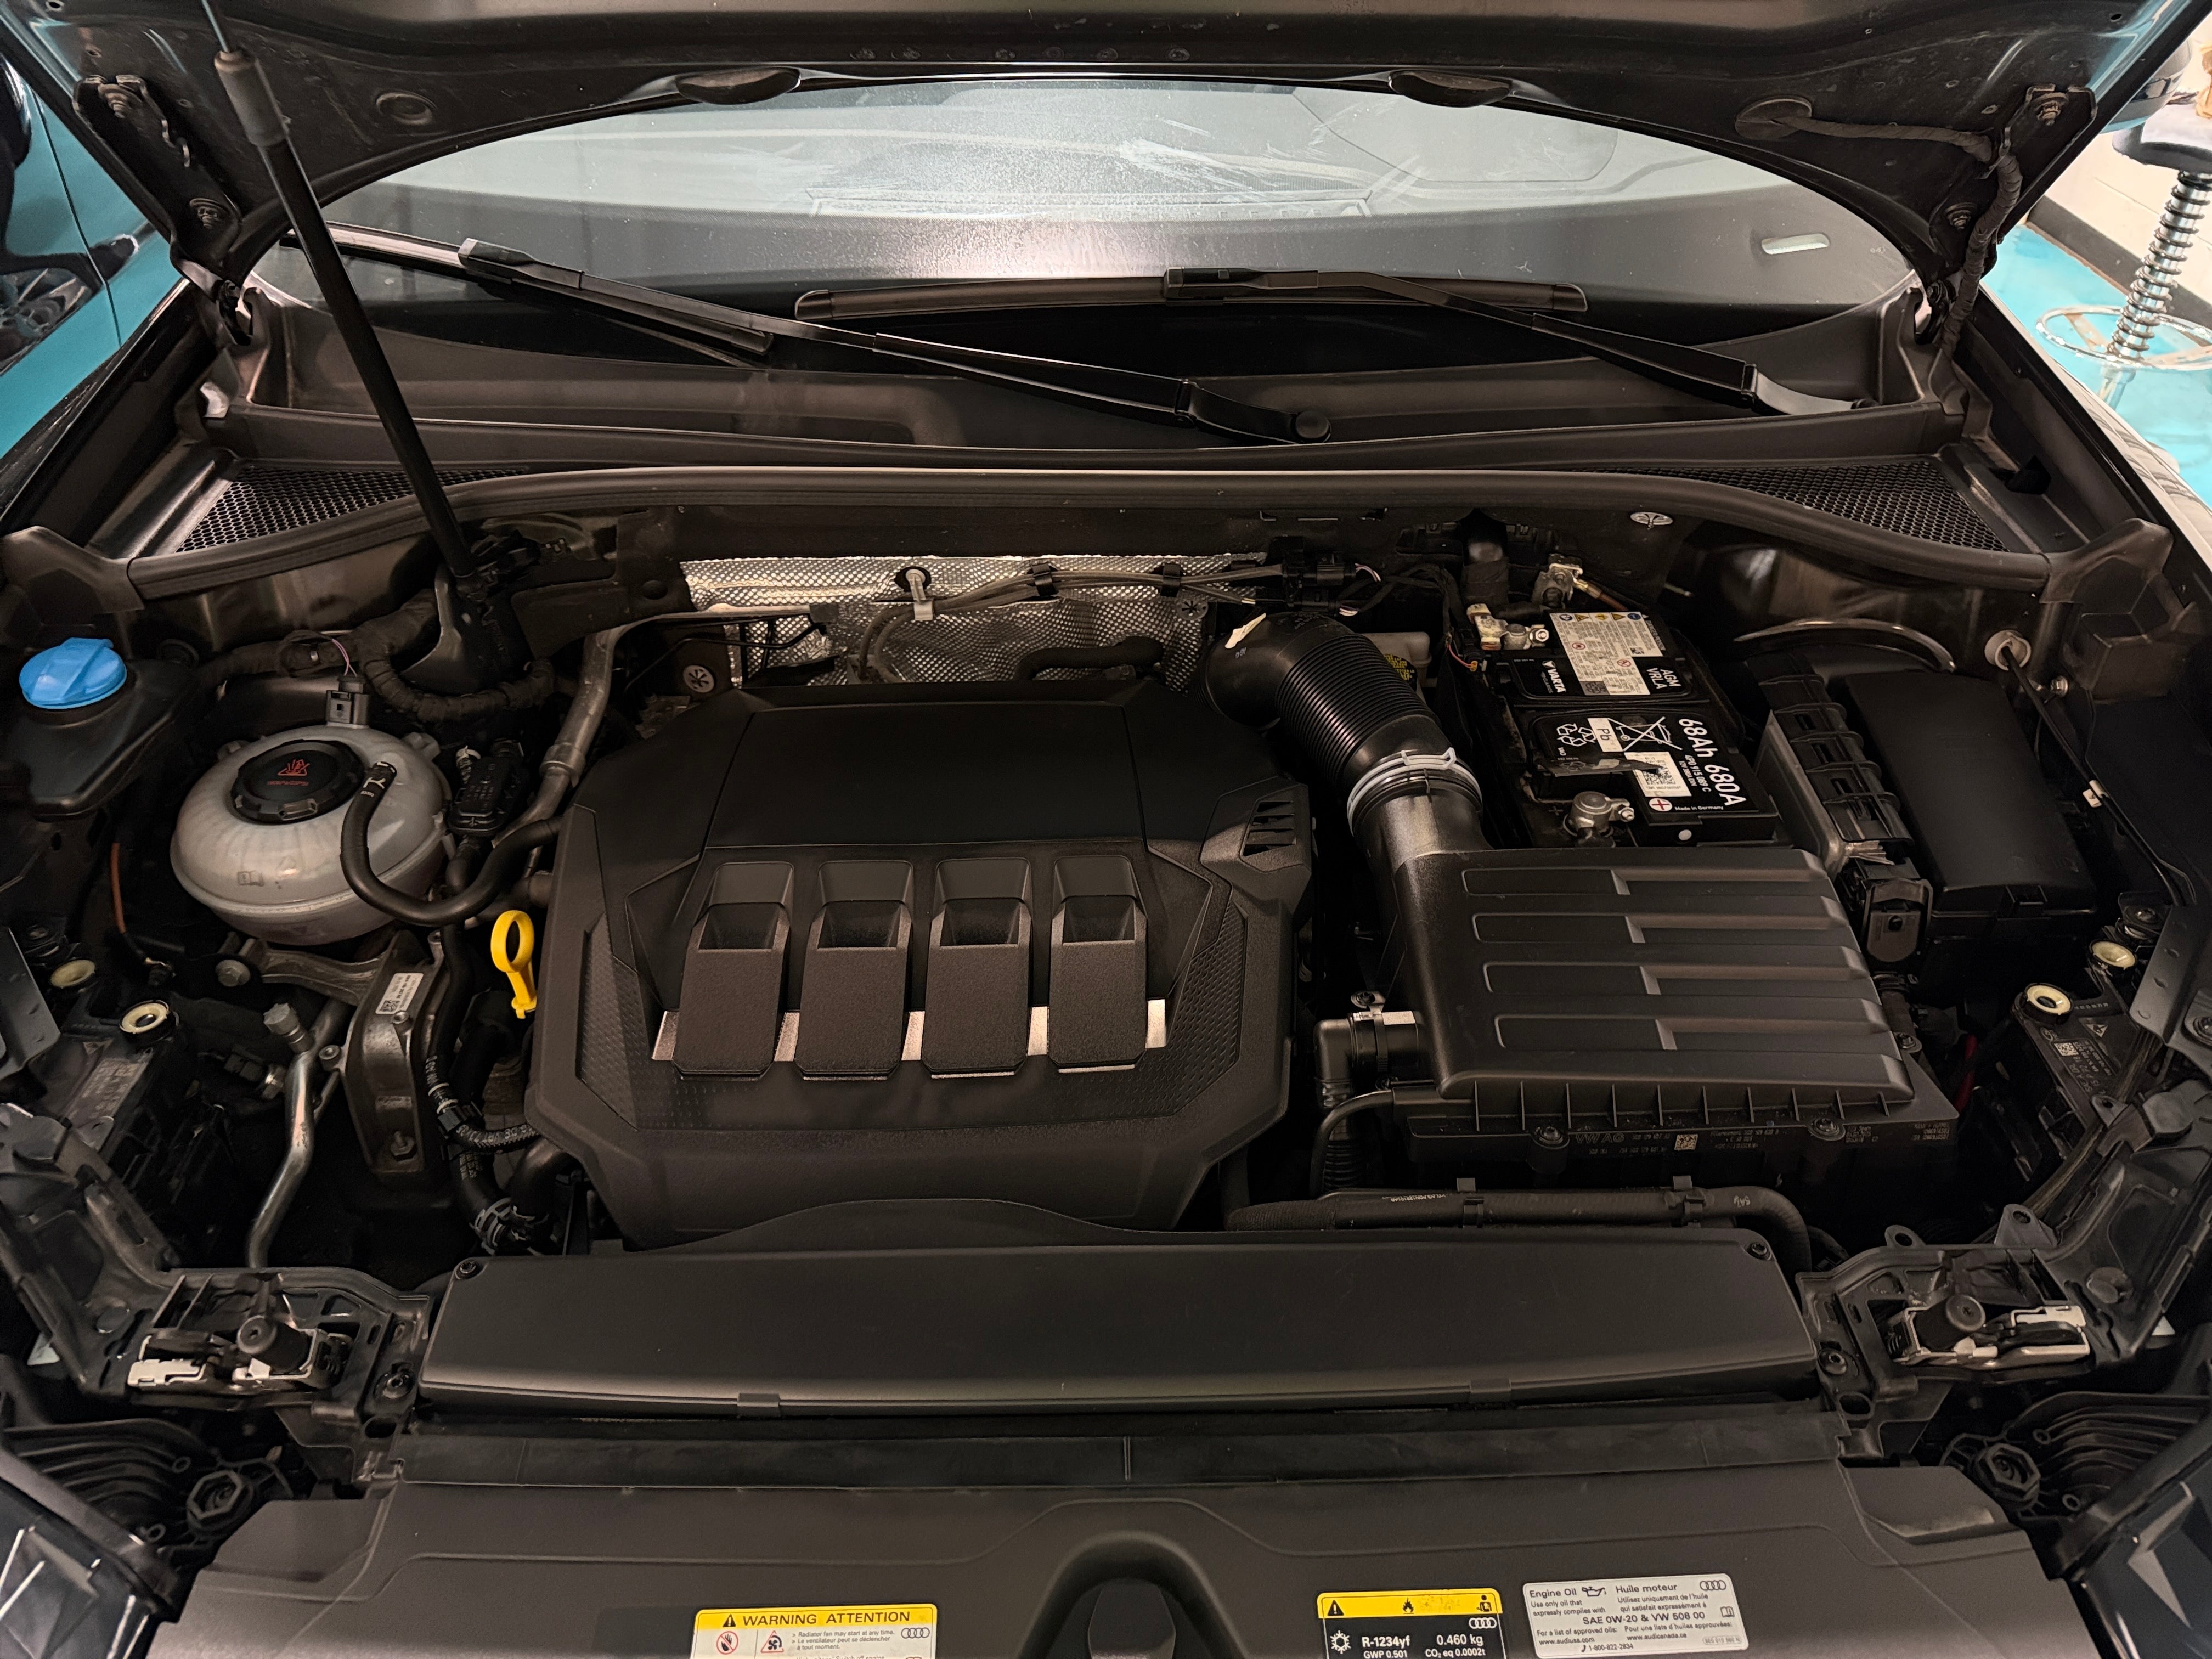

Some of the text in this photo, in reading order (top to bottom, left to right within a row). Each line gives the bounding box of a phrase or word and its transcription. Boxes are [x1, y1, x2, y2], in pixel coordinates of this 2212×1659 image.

[1547, 668, 1567, 693] VARTA
[1646, 667, 1668, 690] VRLA
[1660, 669, 1681, 687] AGM
[1596, 729, 1610, 740] Pb
[1679, 718, 1747, 806] 68Ah 680A
[1530, 1589, 1561, 1599] Engine
[1616, 1585, 1639, 1593] Huile
[1658, 1602, 1701, 1611] expressément
[743, 1612, 910, 1626] WARNING ATTENTION
[1606, 1615, 1638, 1623] 0W-20
[1651, 1613, 1669, 1621] VW
[1673, 1612, 1691, 1620] 508
[1573, 1627, 1602, 1635] approved
[1627, 1632, 1687, 1641] www.audicanada.ca
[1362, 1633, 1483, 1649] R-1234yf 0.460 kg
[1363, 1650, 1384, 1659] GWP
[1386, 1650, 1407, 1658] 0.501
[1443, 1650, 1453, 1658] eq
[1455, 1647, 1486, 1657] 0.0002t
